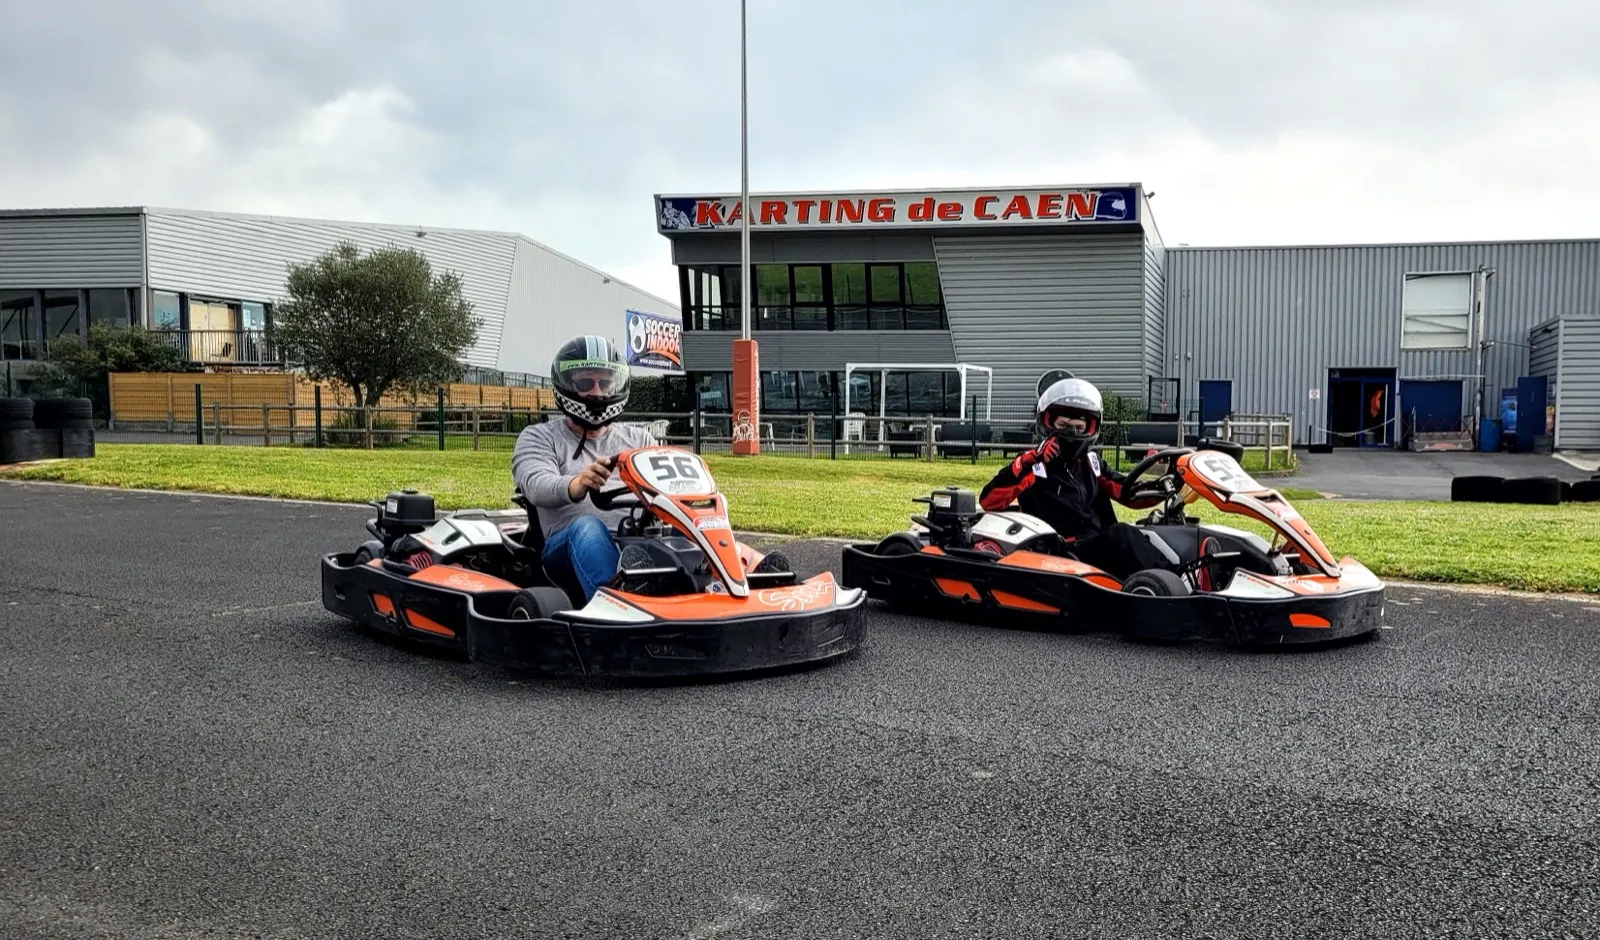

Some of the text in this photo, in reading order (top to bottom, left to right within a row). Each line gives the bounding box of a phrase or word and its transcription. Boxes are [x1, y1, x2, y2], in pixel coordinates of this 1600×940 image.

[695, 191, 1097, 228] KARTING de CAEN
[645, 318, 680, 339] SOCCER
[646, 333, 680, 354] INDOOR
[649, 455, 700, 481] 56
